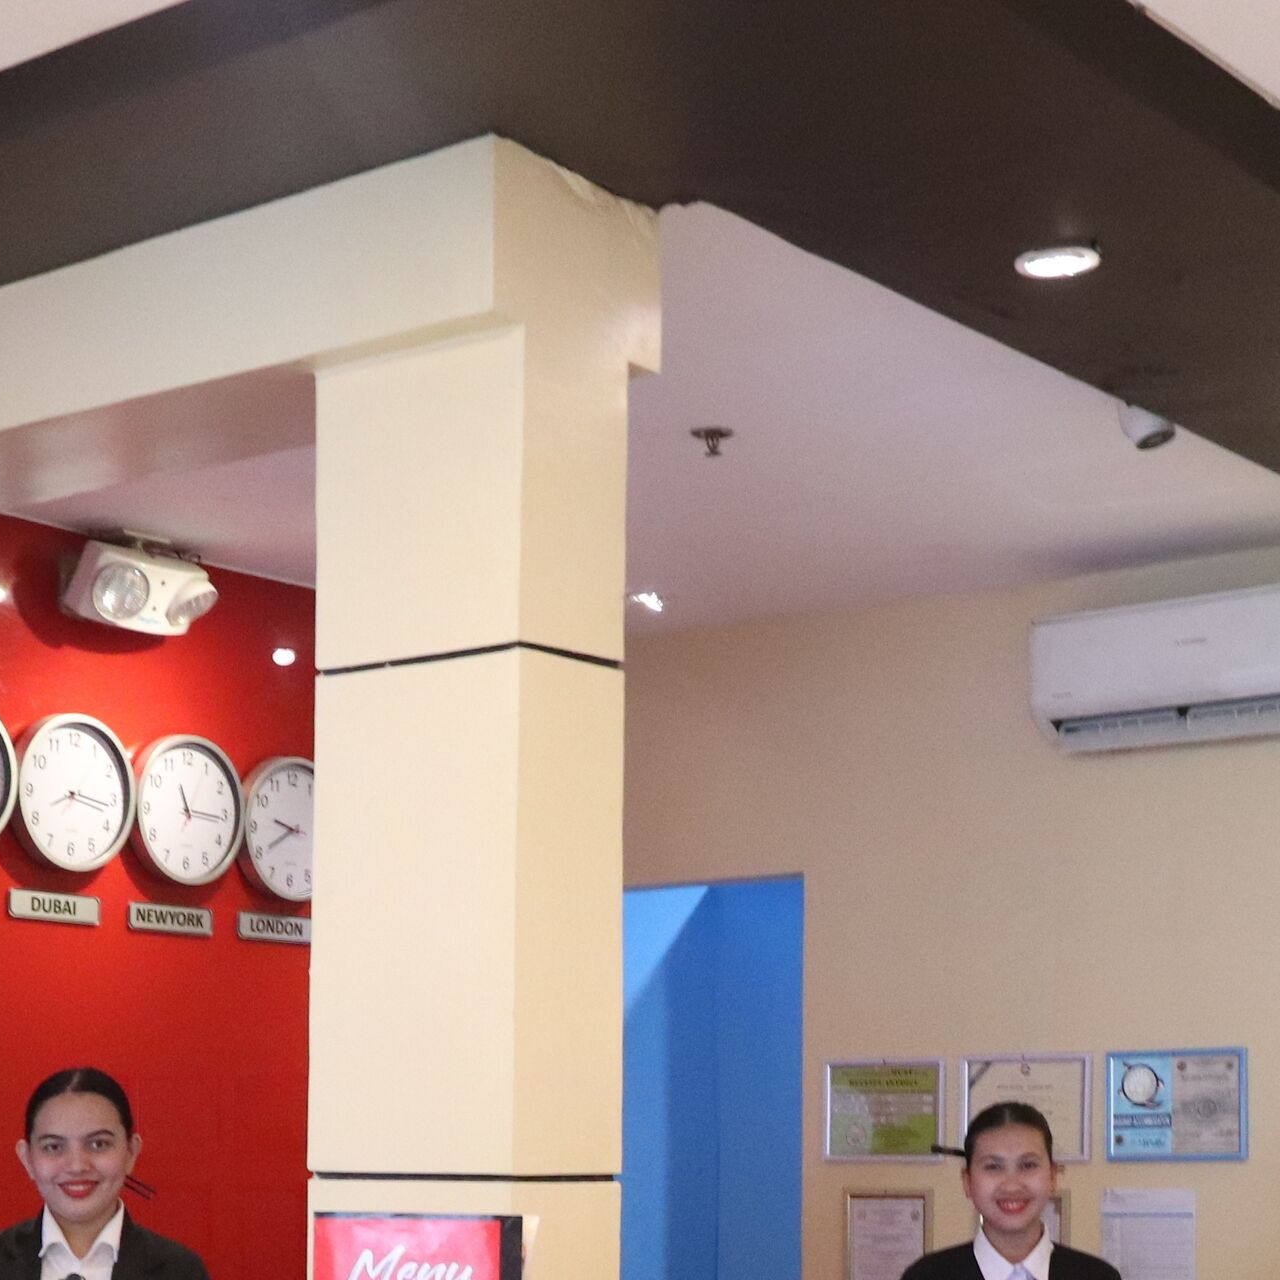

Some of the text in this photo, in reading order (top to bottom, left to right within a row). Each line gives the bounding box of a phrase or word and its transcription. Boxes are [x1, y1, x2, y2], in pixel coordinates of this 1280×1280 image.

[49, 737, 59, 752] 11
[69, 732, 81, 748] 12
[33, 754, 47, 770] 10
[164, 758, 174, 771] 11
[182, 751, 193, 766] 12
[106, 764, 112, 779] 2
[288, 770, 298, 788] 12
[150, 774, 162, 789] 10
[217, 780, 223, 795] 2
[270, 777, 279, 792] 11
[25, 782, 34, 797] 9
[110, 793, 117, 807] 3
[256, 793, 268, 809] 10
[143, 801, 150, 815] 9
[221, 809, 228, 822] 3
[31, 810, 40, 825] 8
[103, 819, 110, 832] 4
[47, 833, 54, 847] 7
[149, 828, 156, 841] 8
[215, 834, 221, 846] 4
[67, 842, 75, 856] 6
[88, 837, 95, 852] 5
[164, 849, 170, 862] 7
[182, 856, 190, 870] 6
[202, 851, 208, 866] 5
[269, 865, 275, 879] 7
[286, 873, 294, 888] 6
[31, 896, 77, 916] DUBAI
[136, 908, 204, 928] NEWYORK
[250, 918, 303, 937] LONDON
